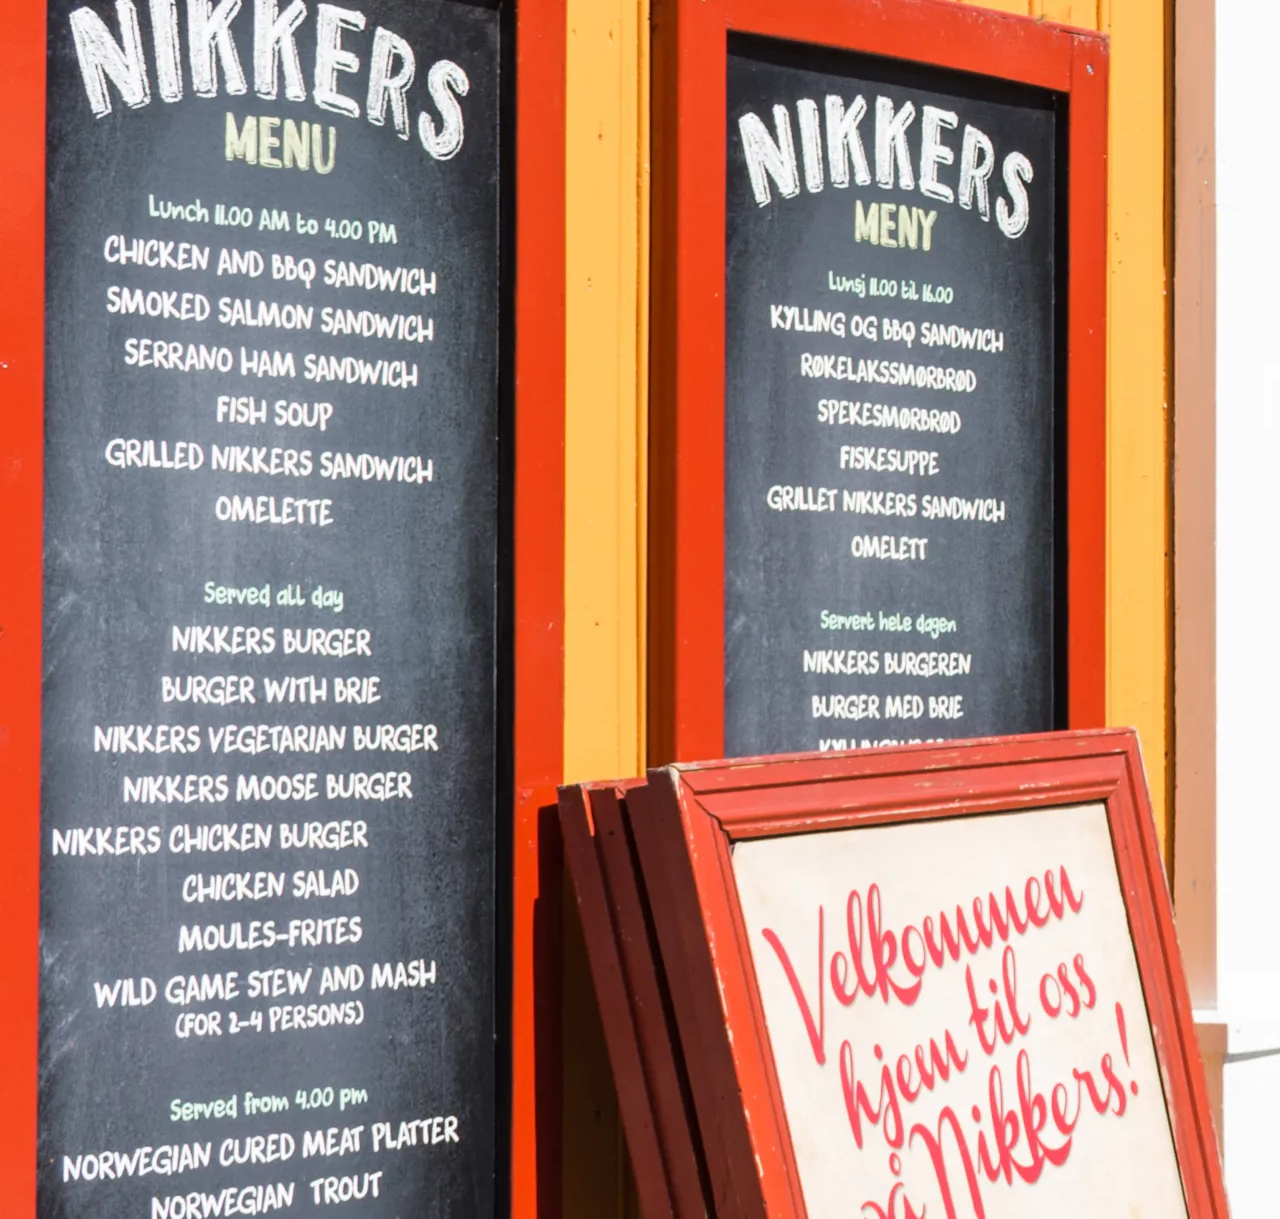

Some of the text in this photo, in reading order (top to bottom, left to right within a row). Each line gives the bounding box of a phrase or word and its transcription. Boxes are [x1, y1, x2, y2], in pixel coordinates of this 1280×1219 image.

[225, 112, 336, 174] MENU
[737, 93, 1033, 240] NIKKERS
[149, 194, 397, 244] Lunch 11.00 AM to 4.00 PM
[855, 200, 937, 251] MENY
[104, 235, 436, 296] CHICKEN AND BBQ SANDWICH
[829, 271, 953, 304] Lunsj 11.00 til 16.00
[106, 286, 433, 343] SMOKED SALMON SANDWICH
[770, 305, 1003, 353] KYLLING OG BBQ SANDWICH
[124, 338, 418, 389] SERRANO HAM SANDWICH
[801, 353, 977, 392] RØKELAKSSMØRBRØD
[216, 396, 333, 430] FISH SOUP
[817, 399, 961, 434] SPEKESMØRBRØD
[104, 438, 433, 484] GRILLED NIKKERS SANDWICH
[840, 445, 940, 476] FISKESUPPE
[215, 496, 334, 526] OMELETTE
[767, 485, 1005, 523] GRILLET NIKKERS SANDWICH
[850, 534, 928, 561] OMELETT
[203, 581, 344, 613] Served all day
[171, 626, 372, 658] NIKKERS BURGER
[820, 610, 957, 639] Servert hele dagen
[803, 649, 971, 678] NIKKERS BURGEREN
[160, 675, 381, 707] BURGER WITH BRIE
[812, 694, 964, 721] BURGER MED BRIE
[93, 724, 438, 755] NIKKERS VEGETARIAN BURGER
[123, 771, 413, 803] NIKKERS MOOSE BURGER
[52, 820, 368, 856] NIKKERS CHICKEN BURGER
[182, 868, 359, 903] CHICKEN SALAD
[178, 916, 362, 953] MOULES-FRITES
[93, 959, 436, 1009] WILD GAME STEW AND MASH
[761, 865, 1083, 1066] Velkommen
[175, 1011, 222, 1038] (FOR
[268, 1000, 364, 1032] PERSONS)
[839, 945, 1097, 1150] hjem til oss
[170, 1087, 368, 1121] Served from 4.00 pm
[908, 1002, 1139, 1219] Nikkers!
[63, 1116, 459, 1182] NORWEGIAN CURED MEAT PLATTER
[152, 1171, 382, 1219] NORWEGIAN TROUT
